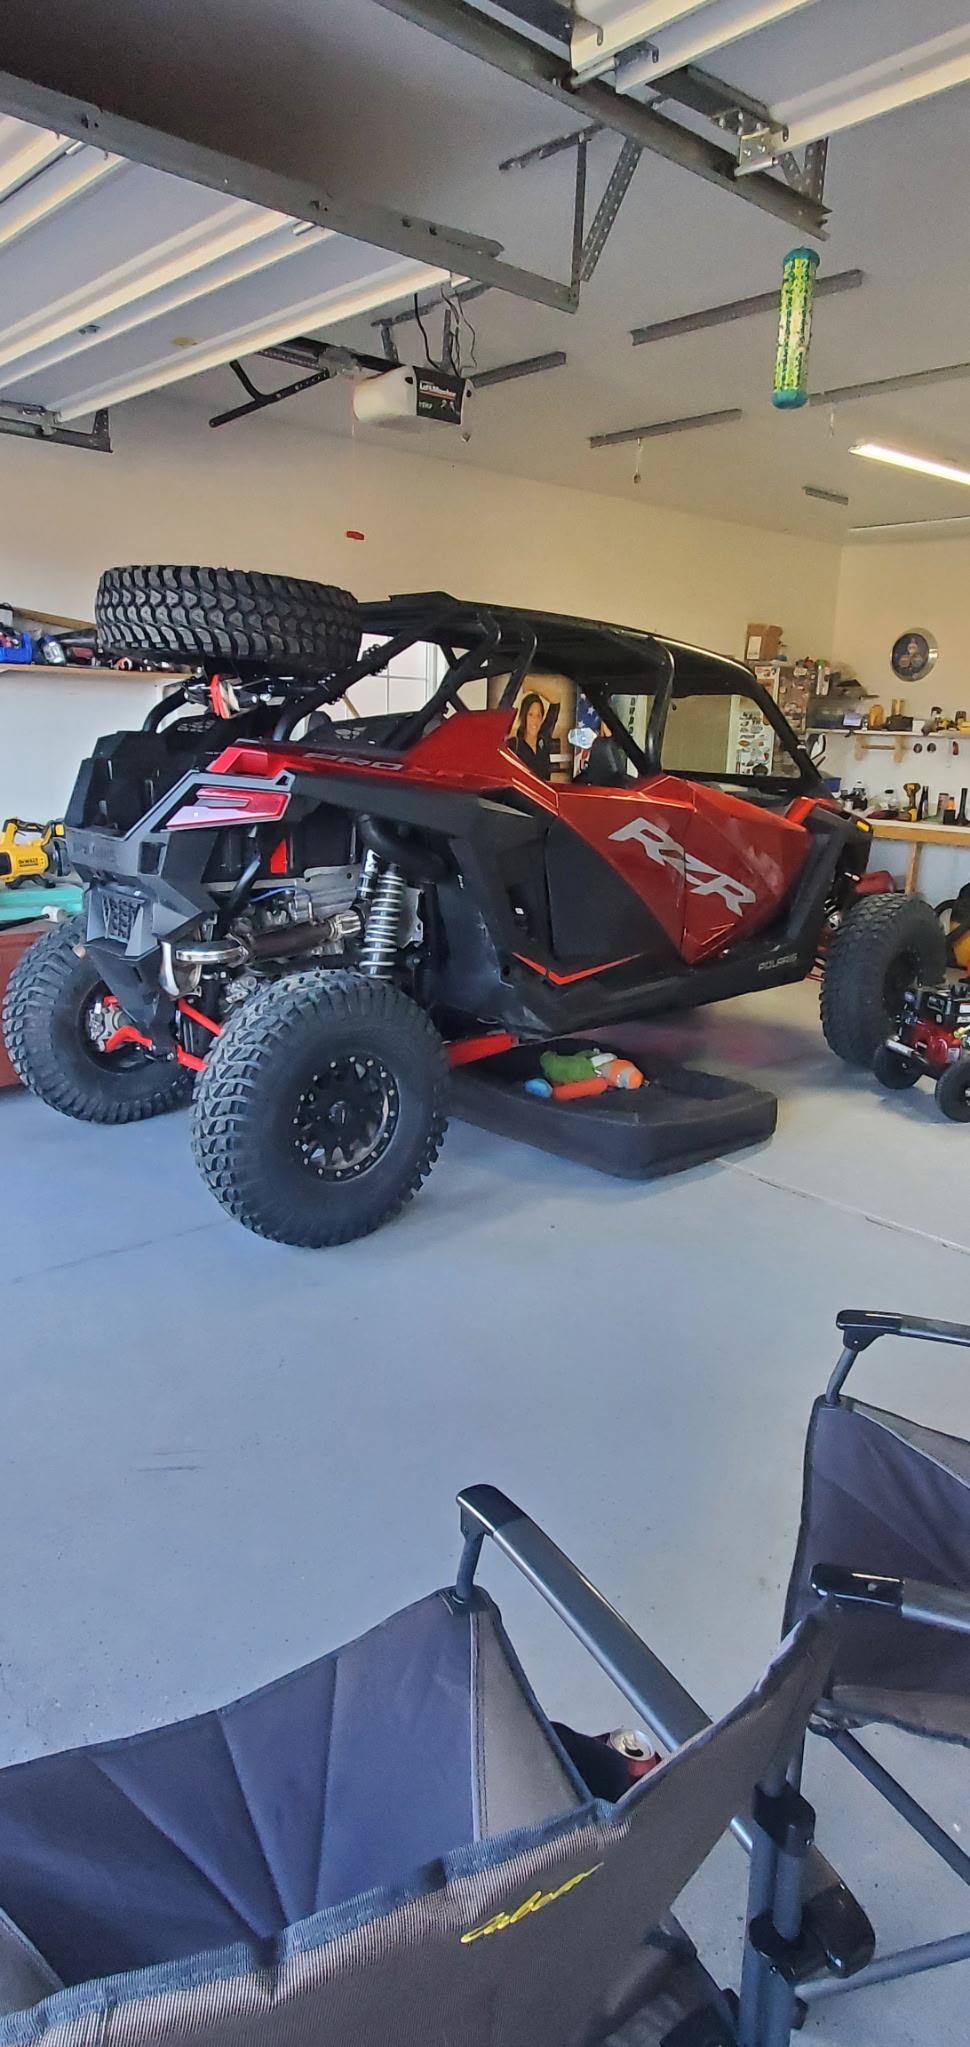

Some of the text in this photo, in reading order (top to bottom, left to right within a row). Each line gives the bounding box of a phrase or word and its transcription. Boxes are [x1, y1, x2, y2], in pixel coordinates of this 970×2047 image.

[303, 752, 404, 771] PRO
[608, 817, 756, 917] RZR
[758, 952, 798, 971] POLARIS
